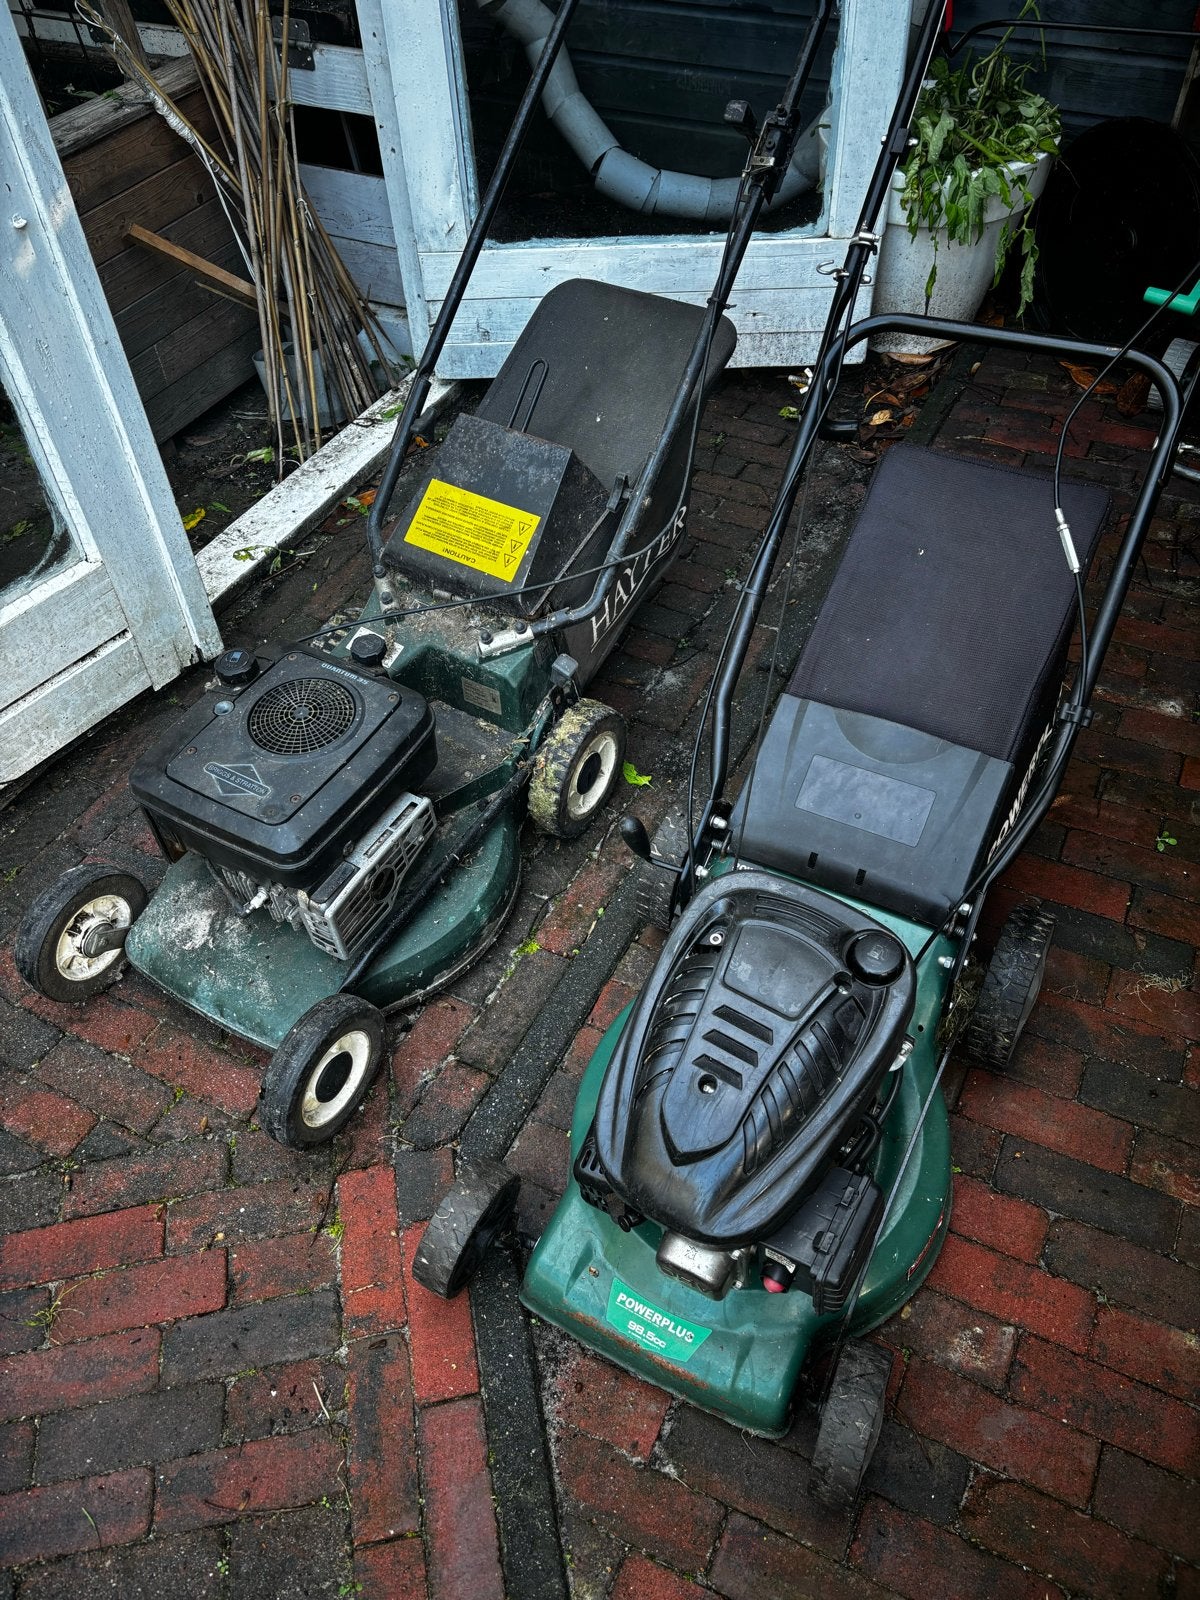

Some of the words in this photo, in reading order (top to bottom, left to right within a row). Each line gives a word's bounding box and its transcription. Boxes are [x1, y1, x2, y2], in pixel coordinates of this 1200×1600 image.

[442, 547, 477, 564] CAUTION!
[589, 505, 687, 648] HAYTER
[321, 662, 357, 680] QUANTUM
[207, 765, 231, 779] BRIGGS
[234, 778, 267, 795] STRATTON
[616, 1292, 695, 1343] POWERPLUS
[627, 1320, 667, 1348] 98.5cc
